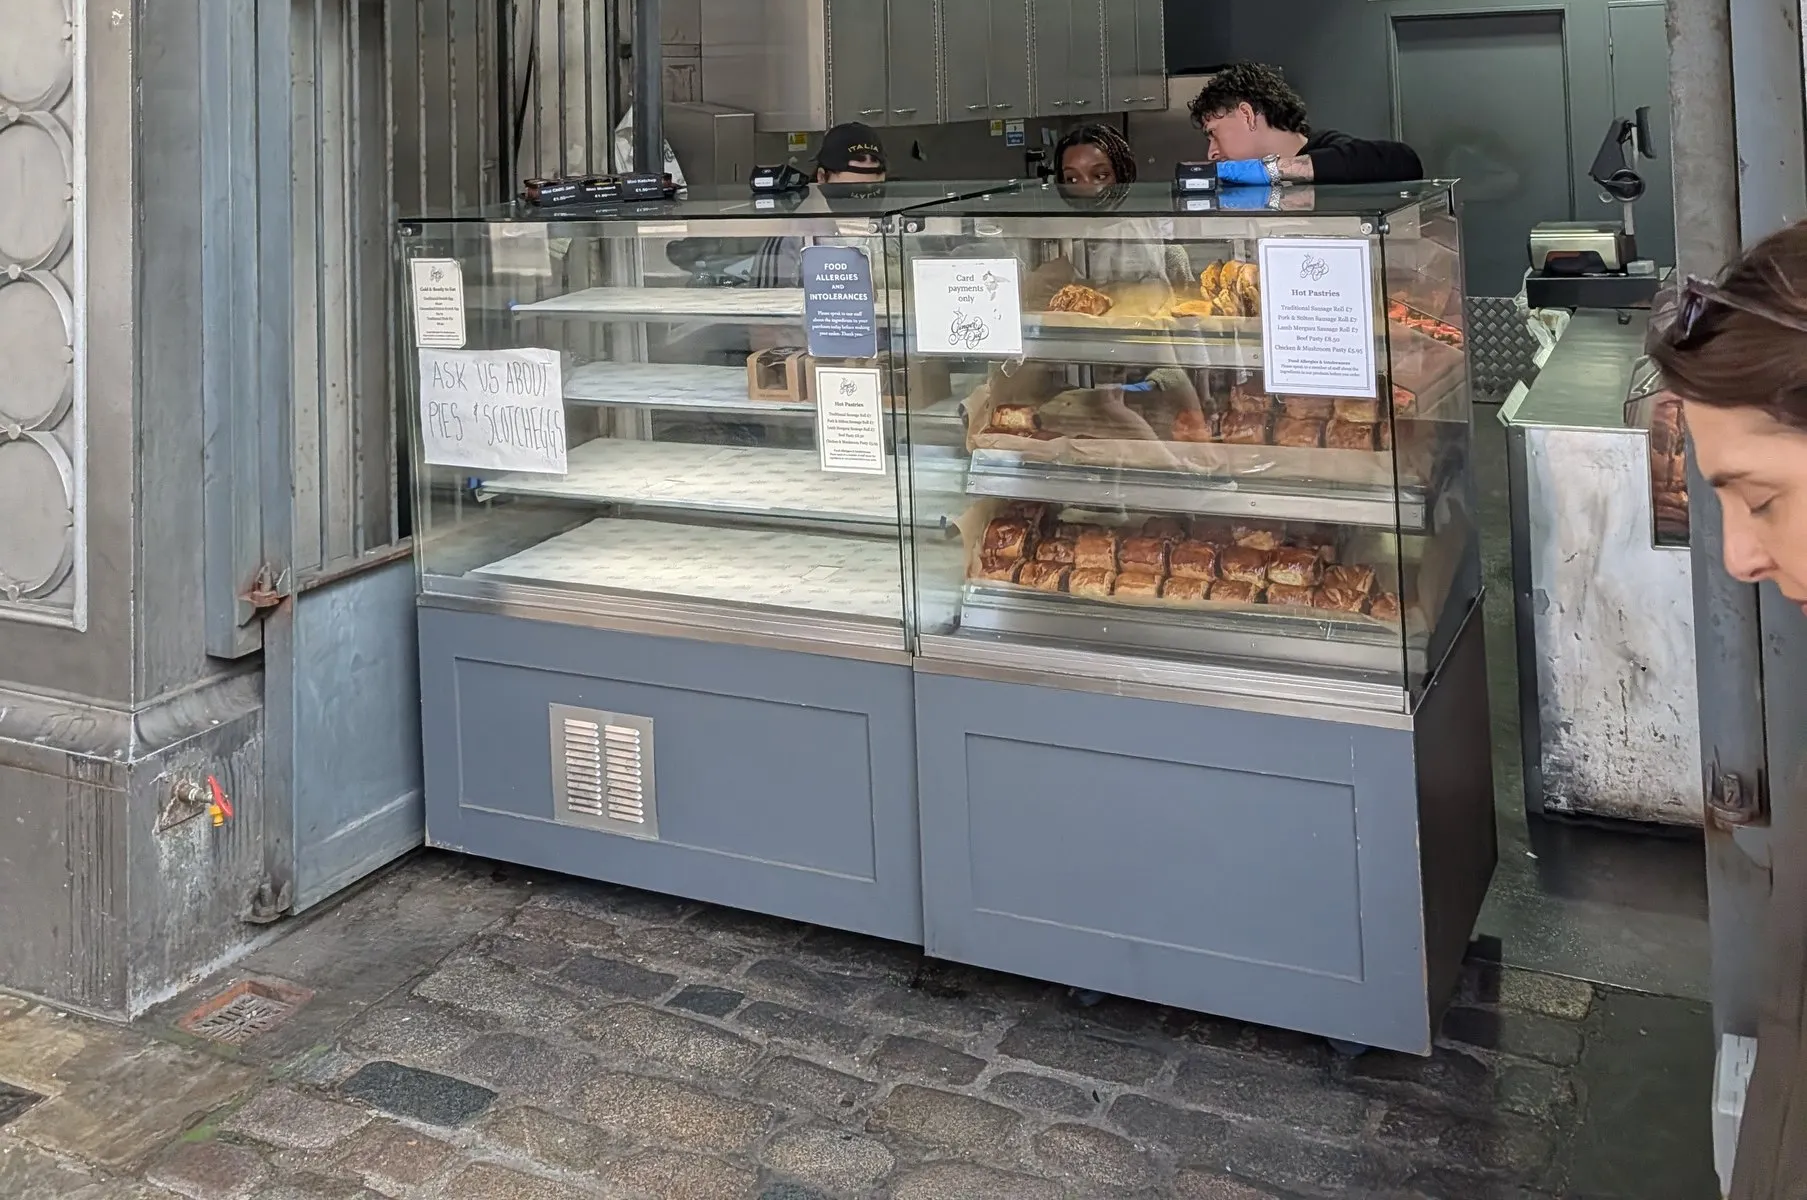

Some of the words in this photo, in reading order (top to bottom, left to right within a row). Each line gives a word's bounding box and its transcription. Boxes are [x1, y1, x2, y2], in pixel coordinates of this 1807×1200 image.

[848, 144, 879, 152] ITALIA
[956, 274, 974, 282] Card
[948, 285, 983, 293] payments
[958, 295, 974, 303] only
[433, 361, 468, 391] ASK
[476, 363, 499, 394] US
[506, 361, 552, 397] ABOUT
[429, 401, 463, 441] PIES
